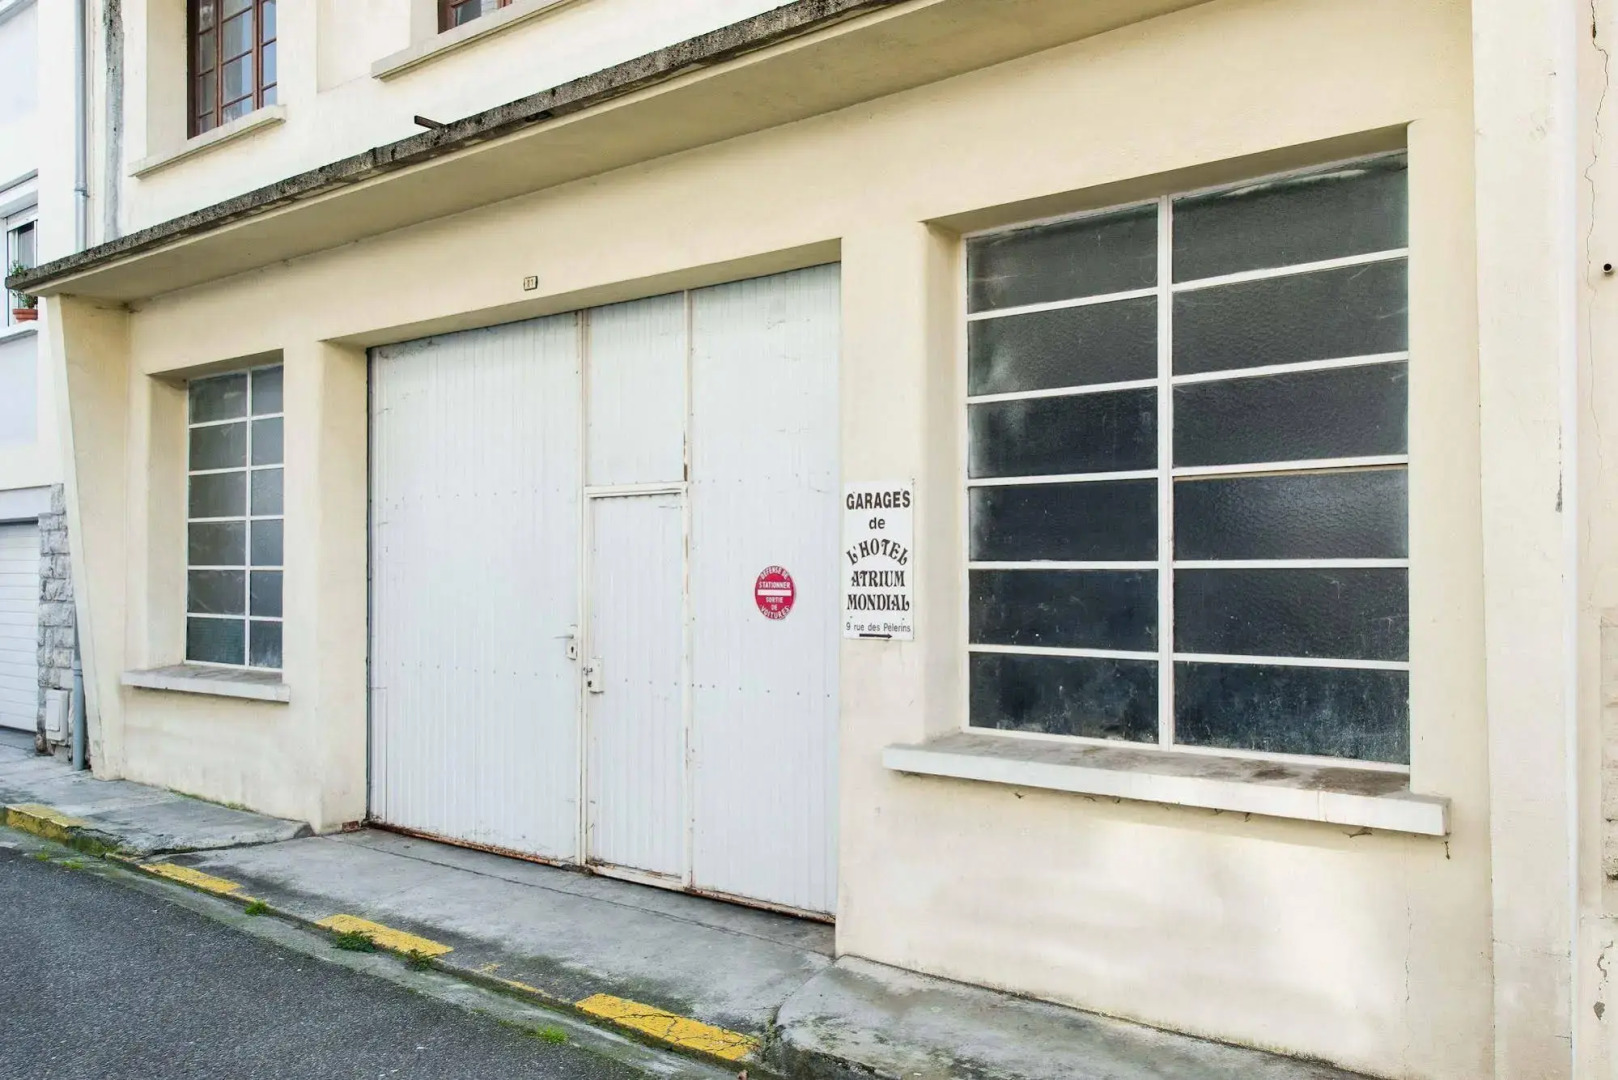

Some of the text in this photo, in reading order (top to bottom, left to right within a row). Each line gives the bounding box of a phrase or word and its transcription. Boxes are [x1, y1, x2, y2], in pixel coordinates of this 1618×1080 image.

[846, 490, 911, 510] GARAGES
[868, 517, 886, 529] de
[846, 538, 908, 566] L'HOTEL
[781, 570, 789, 580] DE
[851, 570, 905, 587] ATRIUM
[758, 581, 791, 589] STATIONNER
[846, 593, 910, 611] MONDIAL
[760, 604, 790, 619] VOITURES
[846, 622, 851, 631] 9
[867, 623, 881, 631] des
